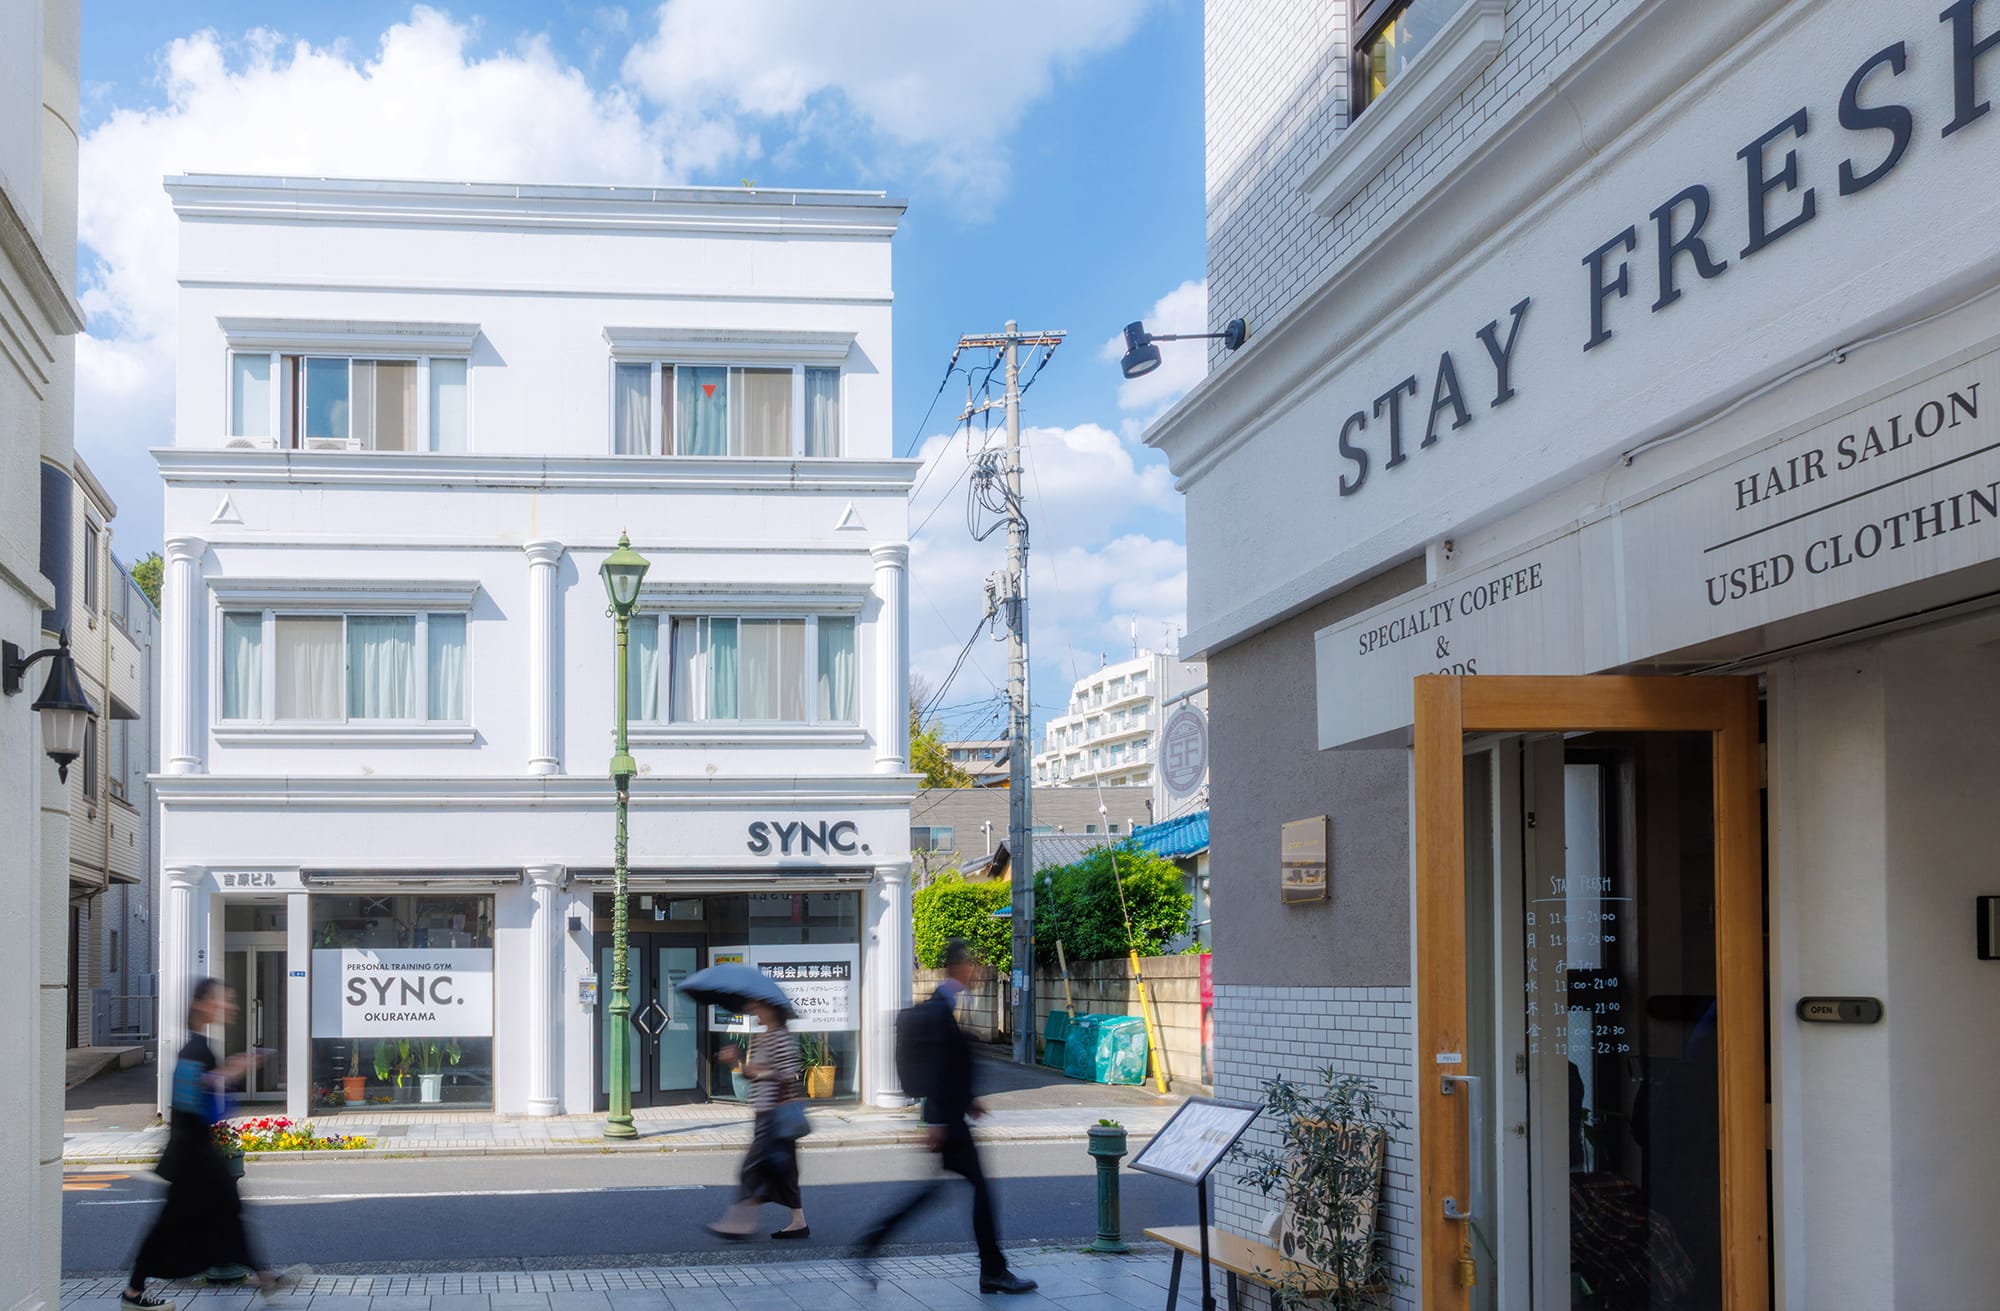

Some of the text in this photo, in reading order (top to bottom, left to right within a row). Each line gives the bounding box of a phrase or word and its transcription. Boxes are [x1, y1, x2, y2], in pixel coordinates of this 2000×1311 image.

[1339, 297, 1530, 496] STAY
[1734, 382, 1981, 511] HAIR SALON
[1705, 553, 1795, 606] USED
[1359, 563, 1543, 656] SPECIALTY COFFEE
[1436, 635, 1450, 659] &
[747, 820, 870, 854] SYNC.
[1550, 876, 1572, 895] STA
[347, 963, 389, 971] PERSONAL
[391, 963, 431, 971] TRAINING
[346, 976, 464, 1006] SYNC.
[364, 1012, 436, 1021] OKURAYAMA
[1811, 1006, 1833, 1014] OPEN
